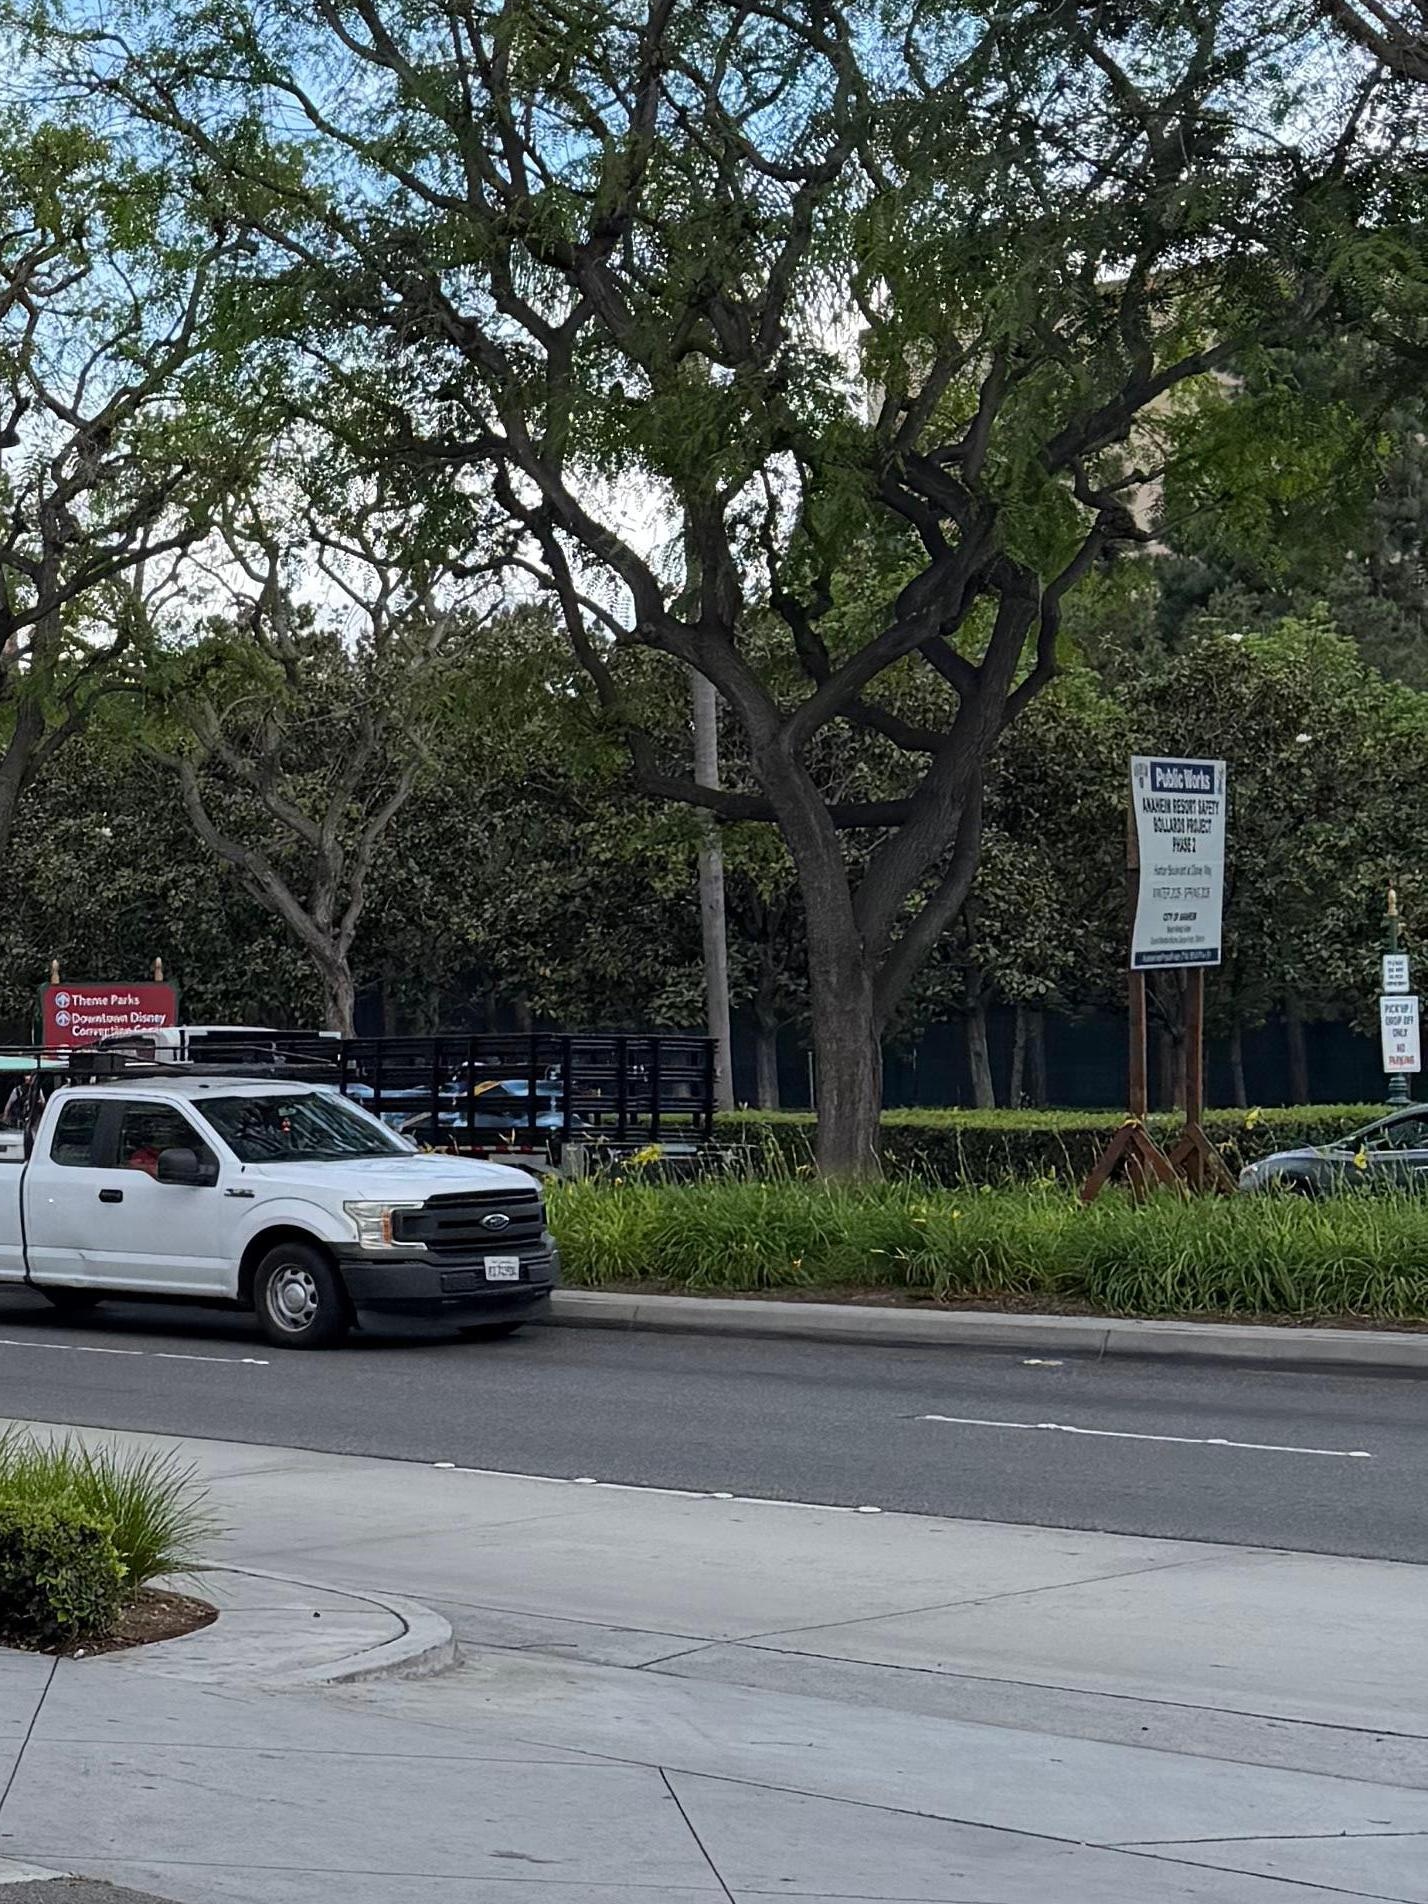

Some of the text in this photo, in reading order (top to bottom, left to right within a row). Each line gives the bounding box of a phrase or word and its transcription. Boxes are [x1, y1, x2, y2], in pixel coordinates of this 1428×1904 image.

[1156, 767, 1210, 790] Public Works
[1143, 797, 1171, 813] ANAHEIM
[1173, 798, 1196, 814] RESORT
[1186, 818, 1212, 834] PROJECT
[72, 994, 140, 1006] Theme Parks
[72, 1012, 166, 1025] Downtown Disney
